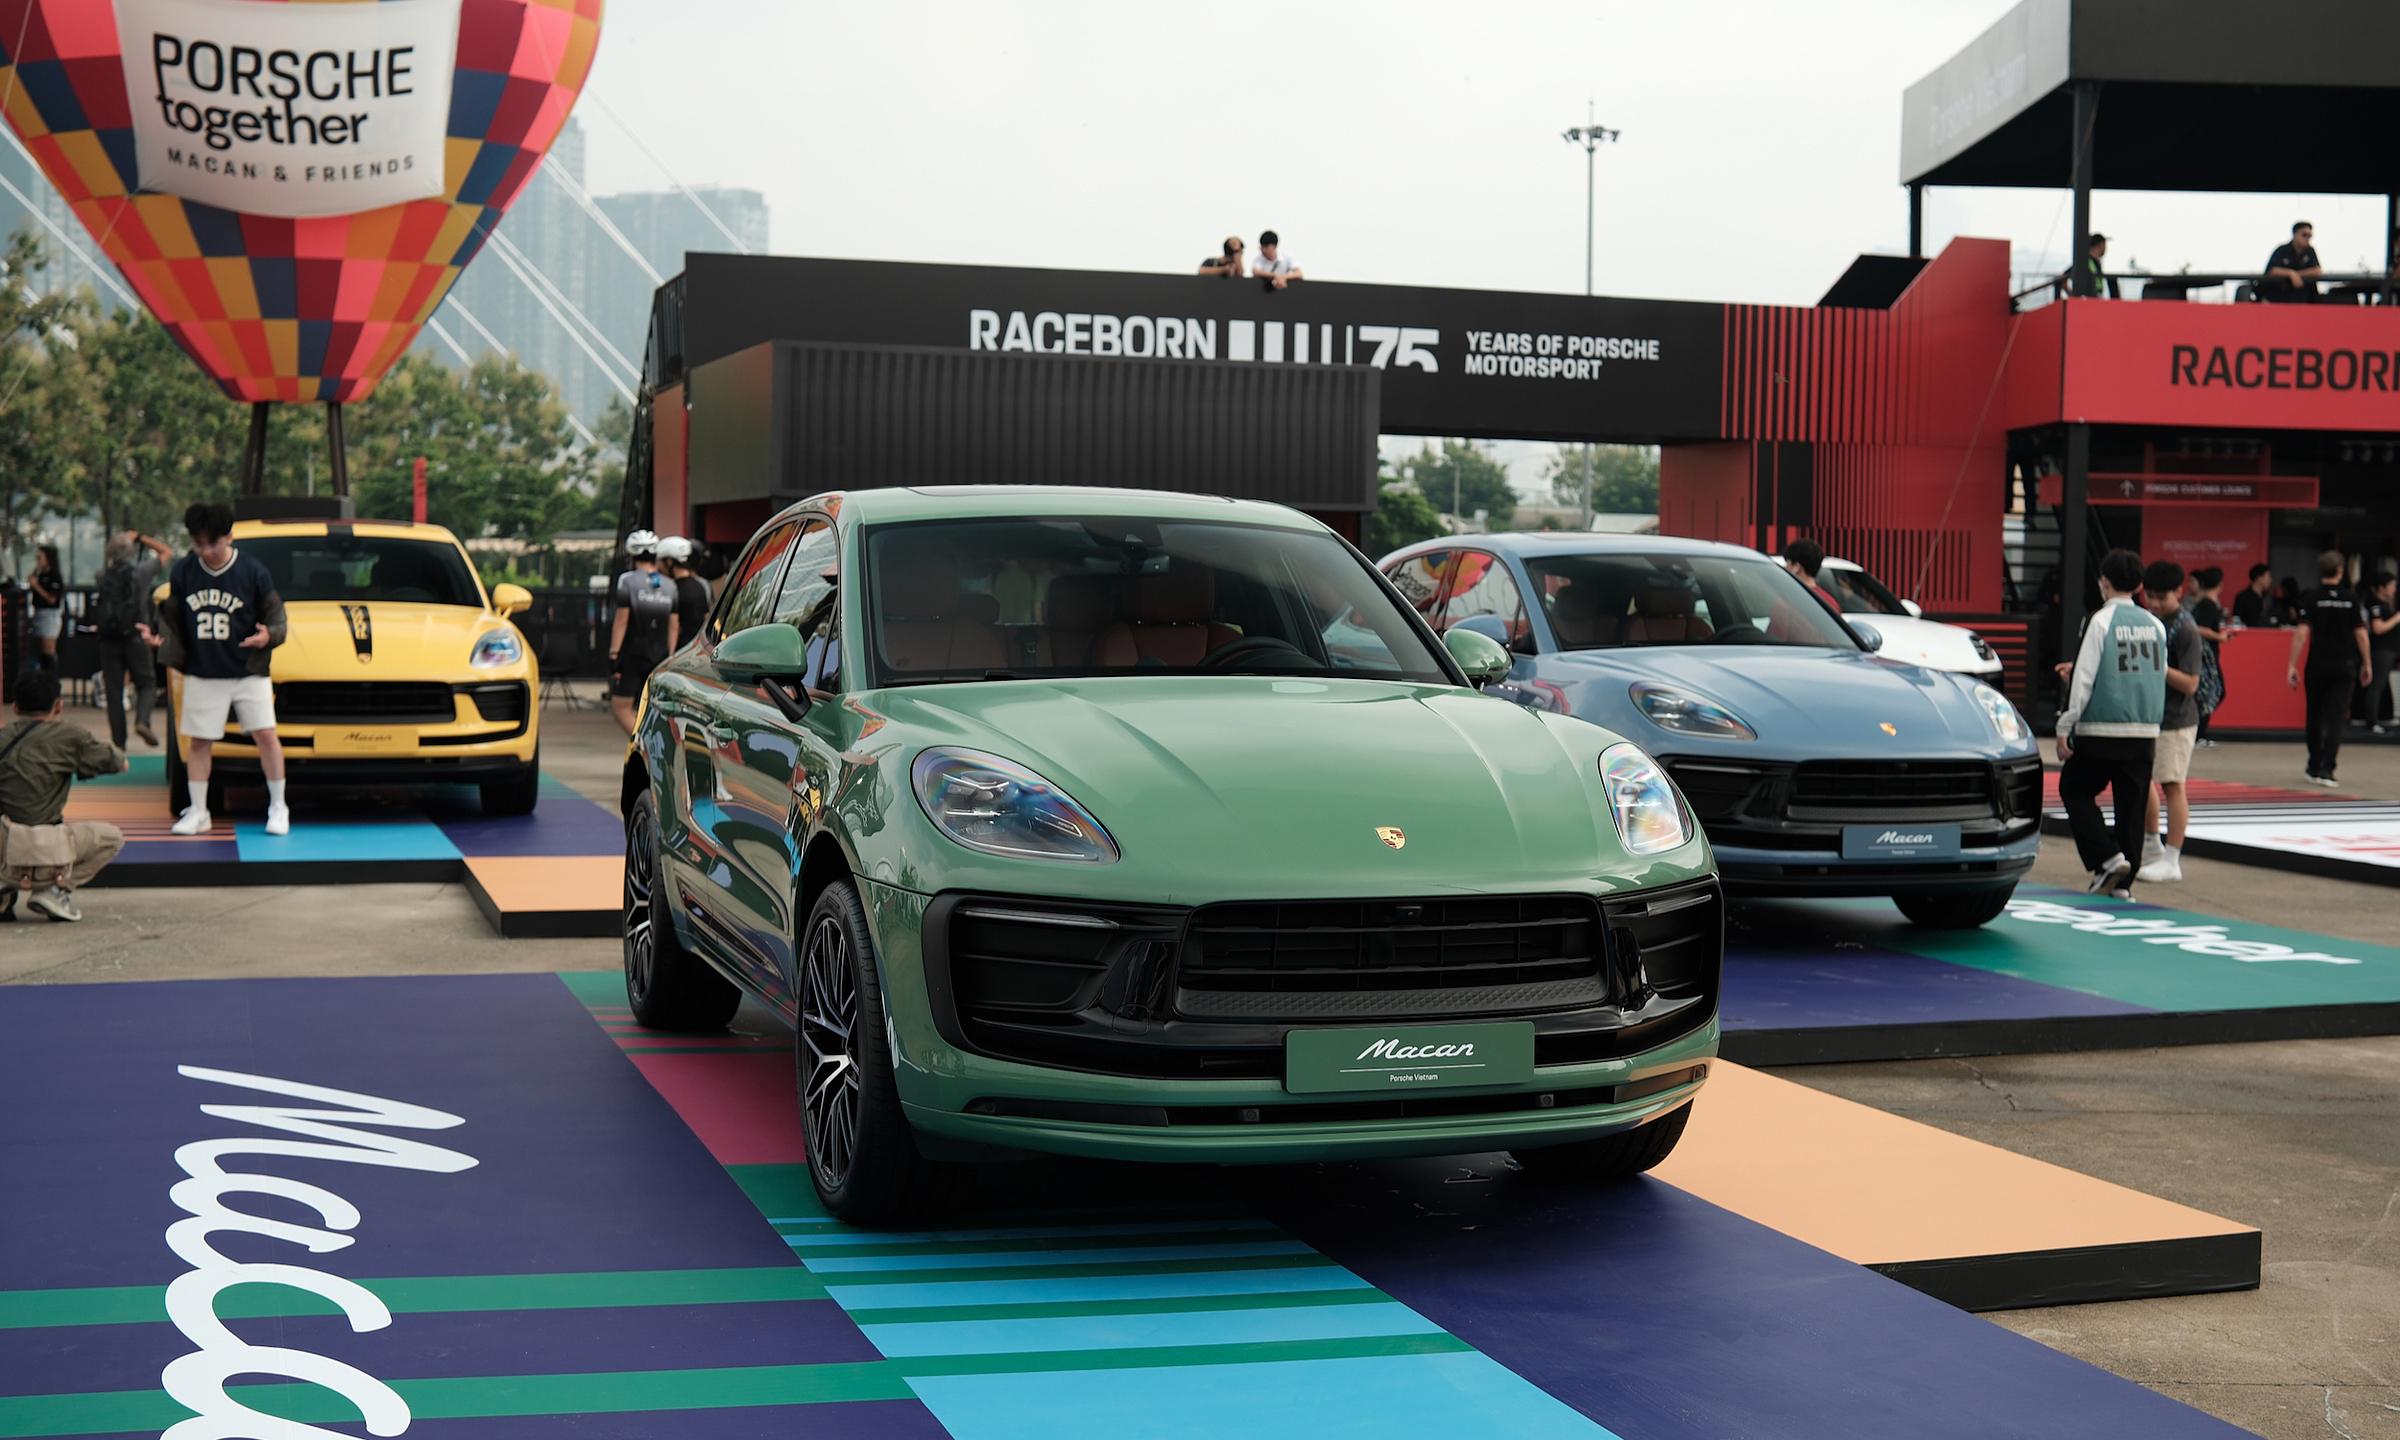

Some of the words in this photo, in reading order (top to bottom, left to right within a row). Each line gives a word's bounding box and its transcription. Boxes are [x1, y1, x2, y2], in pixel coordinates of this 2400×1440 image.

[153, 31, 414, 101] PORSCHE
[156, 94, 368, 150] together
[167, 148, 257, 178] MACAN
[274, 166, 288, 182] &
[305, 155, 415, 182] FRIENDS
[969, 308, 1217, 360] RACEBORN
[1466, 330, 1533, 355] YEARS
[1536, 334, 1564, 356] OF
[1567, 335, 1661, 361] PORSCHE
[1464, 353, 1603, 380] MOTORSPORT
[2171, 344, 2400, 393] RACEBOR
[185, 588, 244, 614] BUDDY
[196, 611, 231, 641] 26
[2116, 640, 2161, 673] 24
[1876, 830, 1933, 844] Macan
[1356, 1038, 1475, 1060] Macan
[1389, 1073, 1413, 1082] Porsche
[1414, 1073, 1439, 1081] Vietnam
